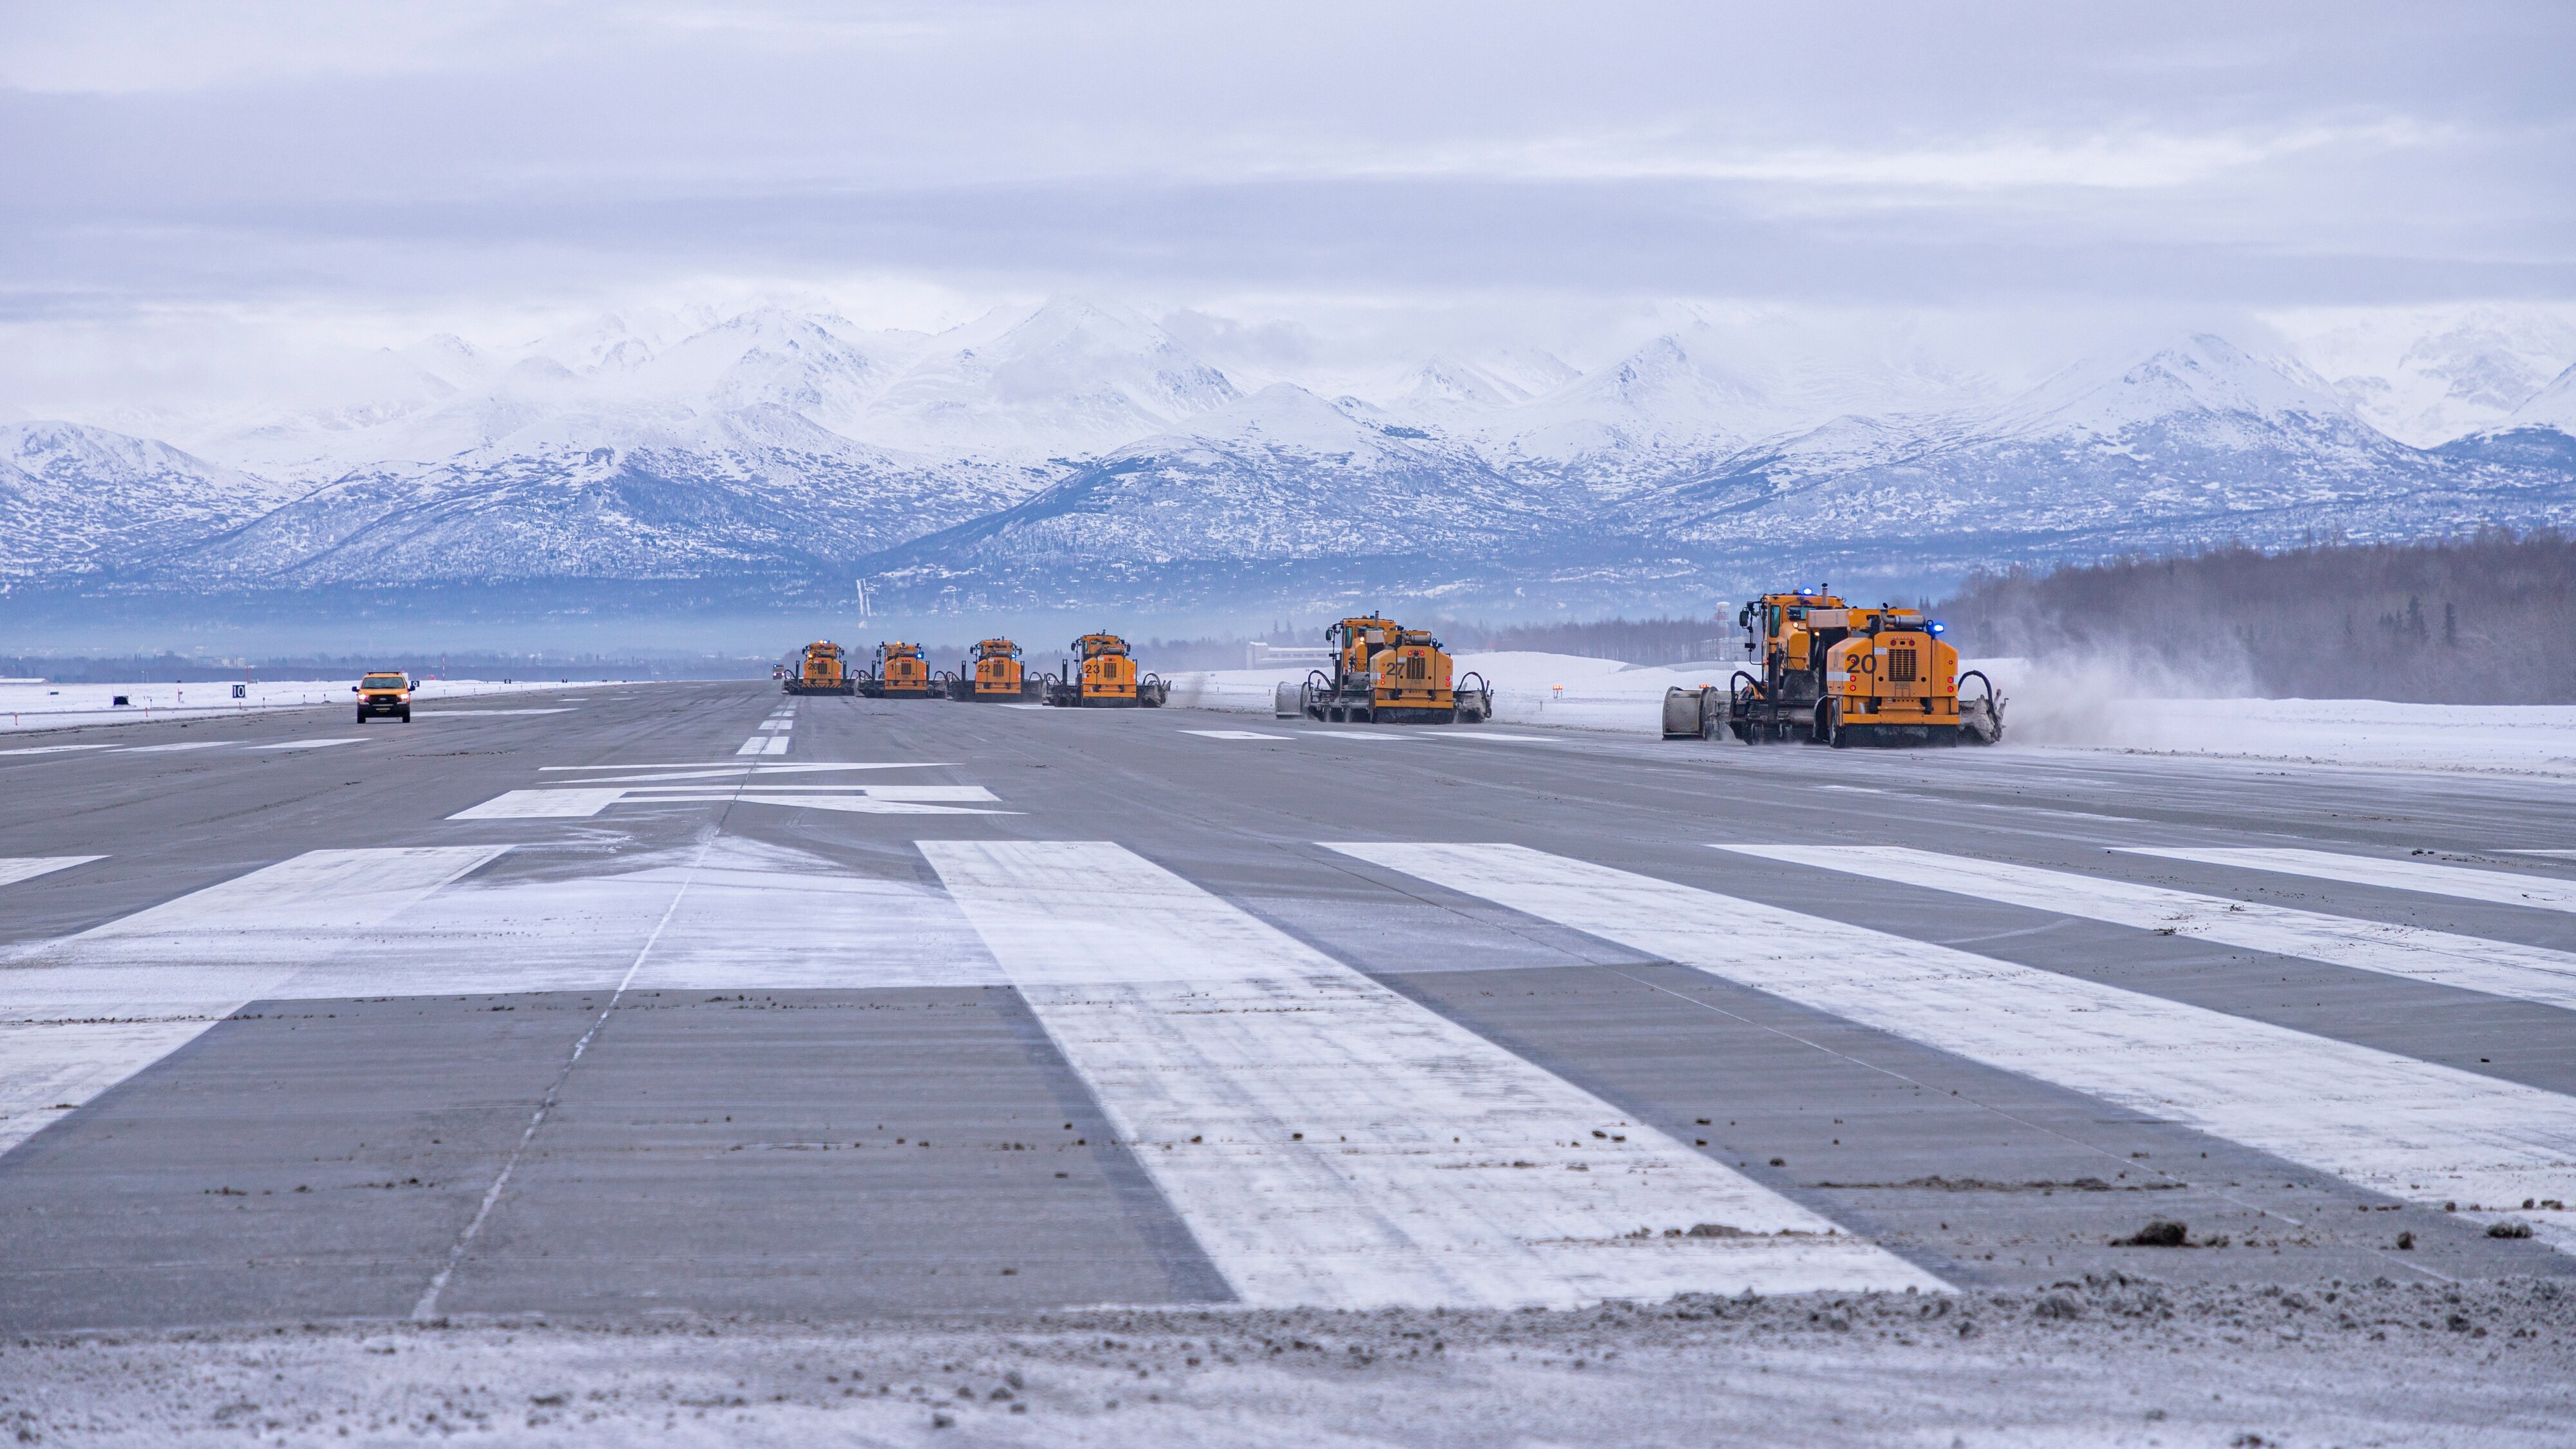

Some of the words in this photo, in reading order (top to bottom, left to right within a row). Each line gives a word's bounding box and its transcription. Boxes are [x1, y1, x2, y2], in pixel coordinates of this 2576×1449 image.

[978, 664, 990, 673] 22
[1085, 664, 1100, 674] 23
[1386, 662, 1405, 676] 27
[1846, 654, 1877, 674] 20
[234, 686, 245, 697] 10
